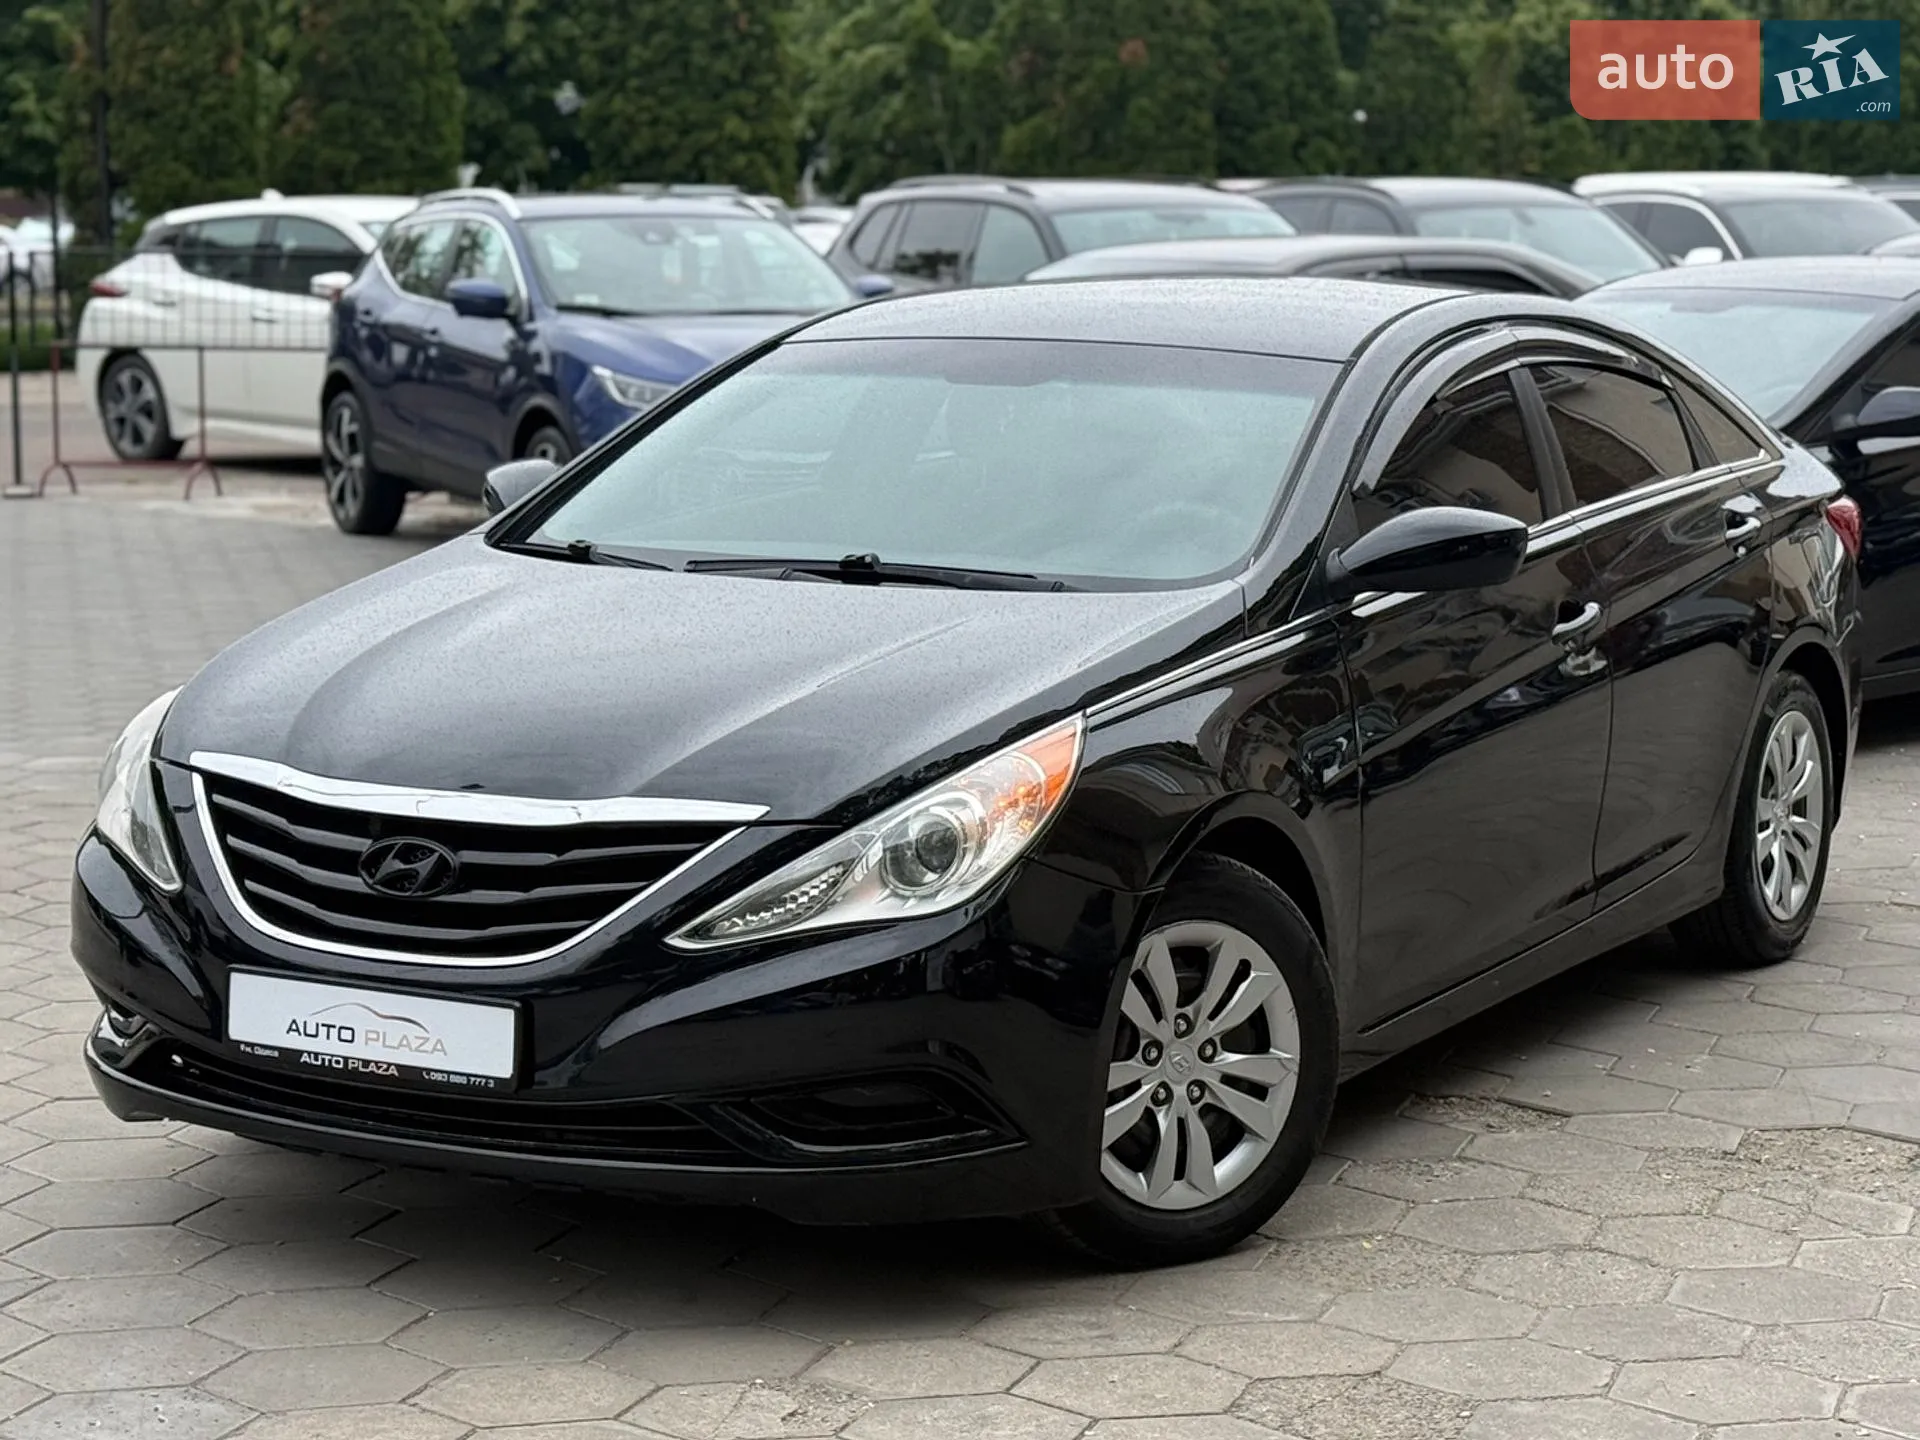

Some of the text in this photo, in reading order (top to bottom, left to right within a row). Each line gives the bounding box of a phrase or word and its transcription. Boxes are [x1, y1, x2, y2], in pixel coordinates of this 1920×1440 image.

[286, 1018, 448, 1057] AUTO PLAZA
[300, 1052, 399, 1076] AUTO PLAZA
